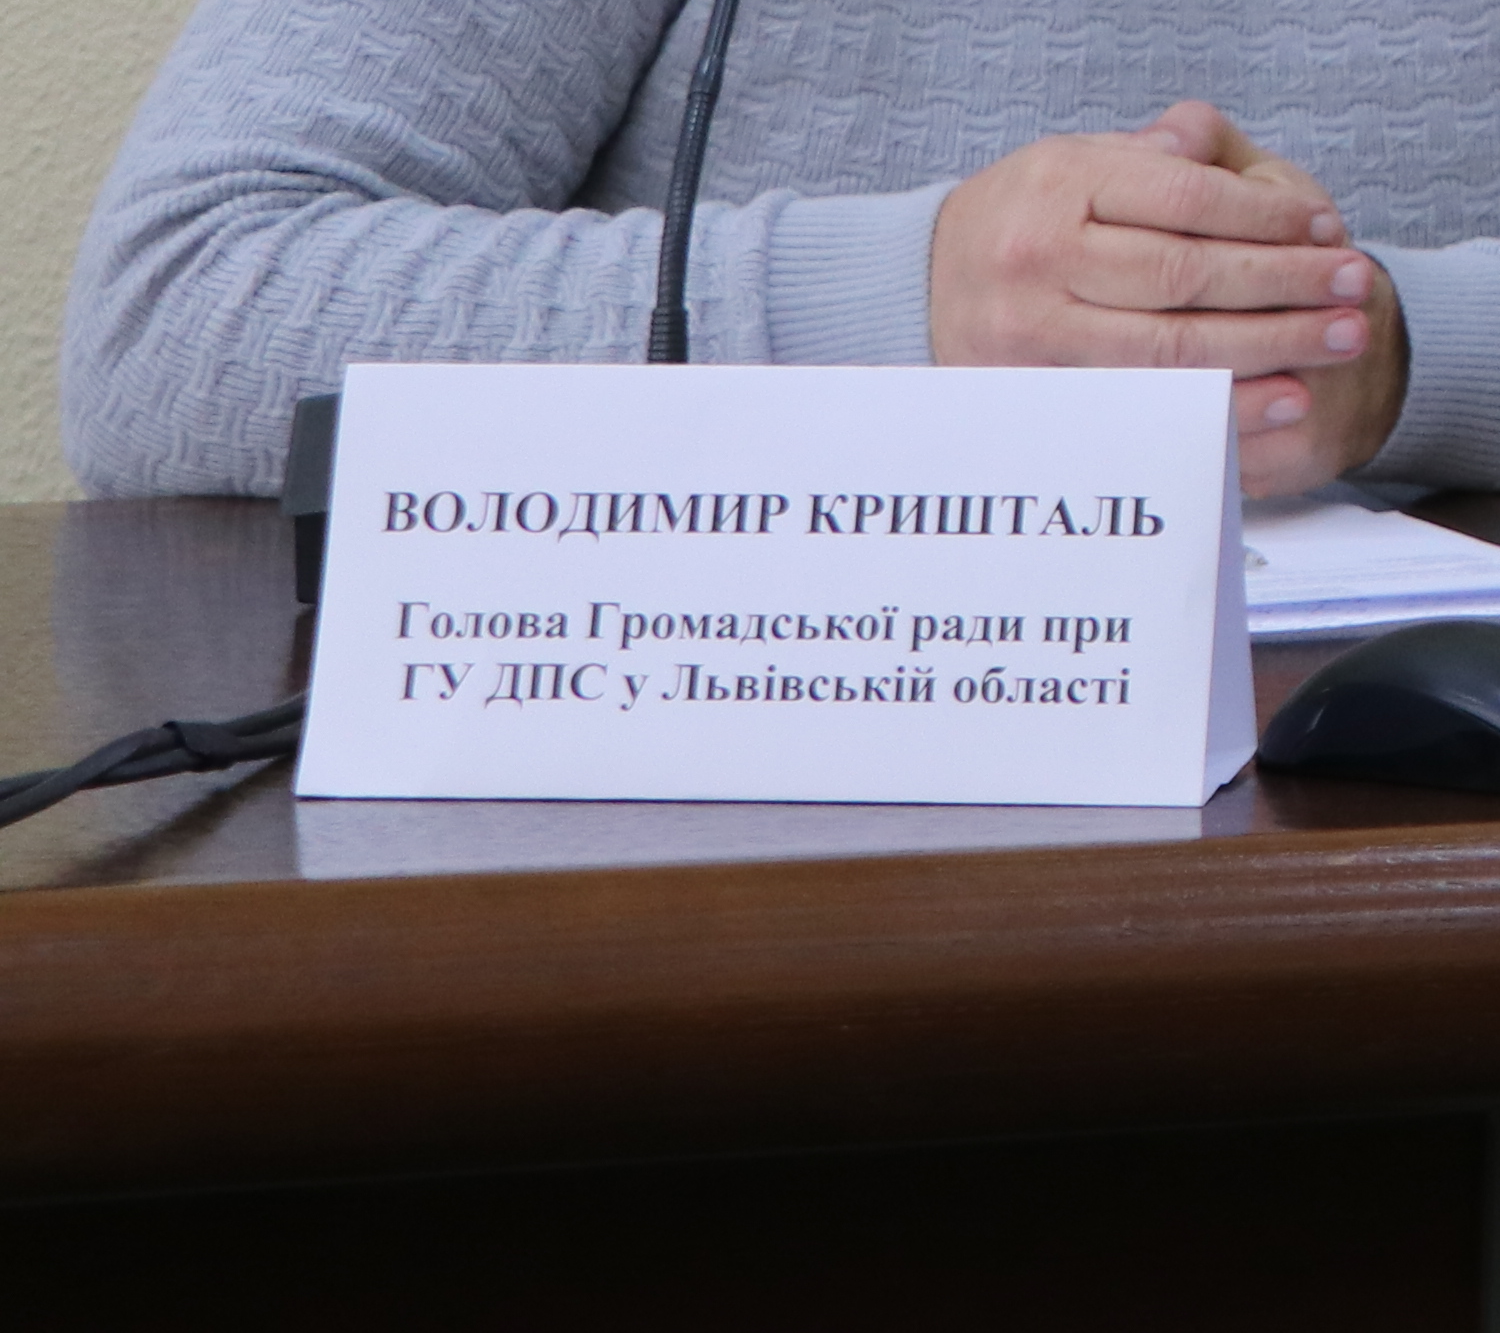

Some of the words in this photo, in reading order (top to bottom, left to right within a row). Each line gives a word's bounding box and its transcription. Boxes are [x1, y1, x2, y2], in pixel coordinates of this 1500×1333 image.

[382, 491, 790, 543] ВОЛОДИМИР
[807, 494, 1166, 537] КРИШТАЛЬ
[396, 601, 569, 641] Голова
[585, 601, 900, 651] Громадської
[909, 614, 1026, 653] ради
[1041, 615, 1133, 654] при
[400, 662, 475, 701] ГУ
[483, 662, 607, 709] ДПС
[620, 674, 650, 712] у
[661, 663, 937, 703] Львівській
[953, 665, 1131, 706] області
